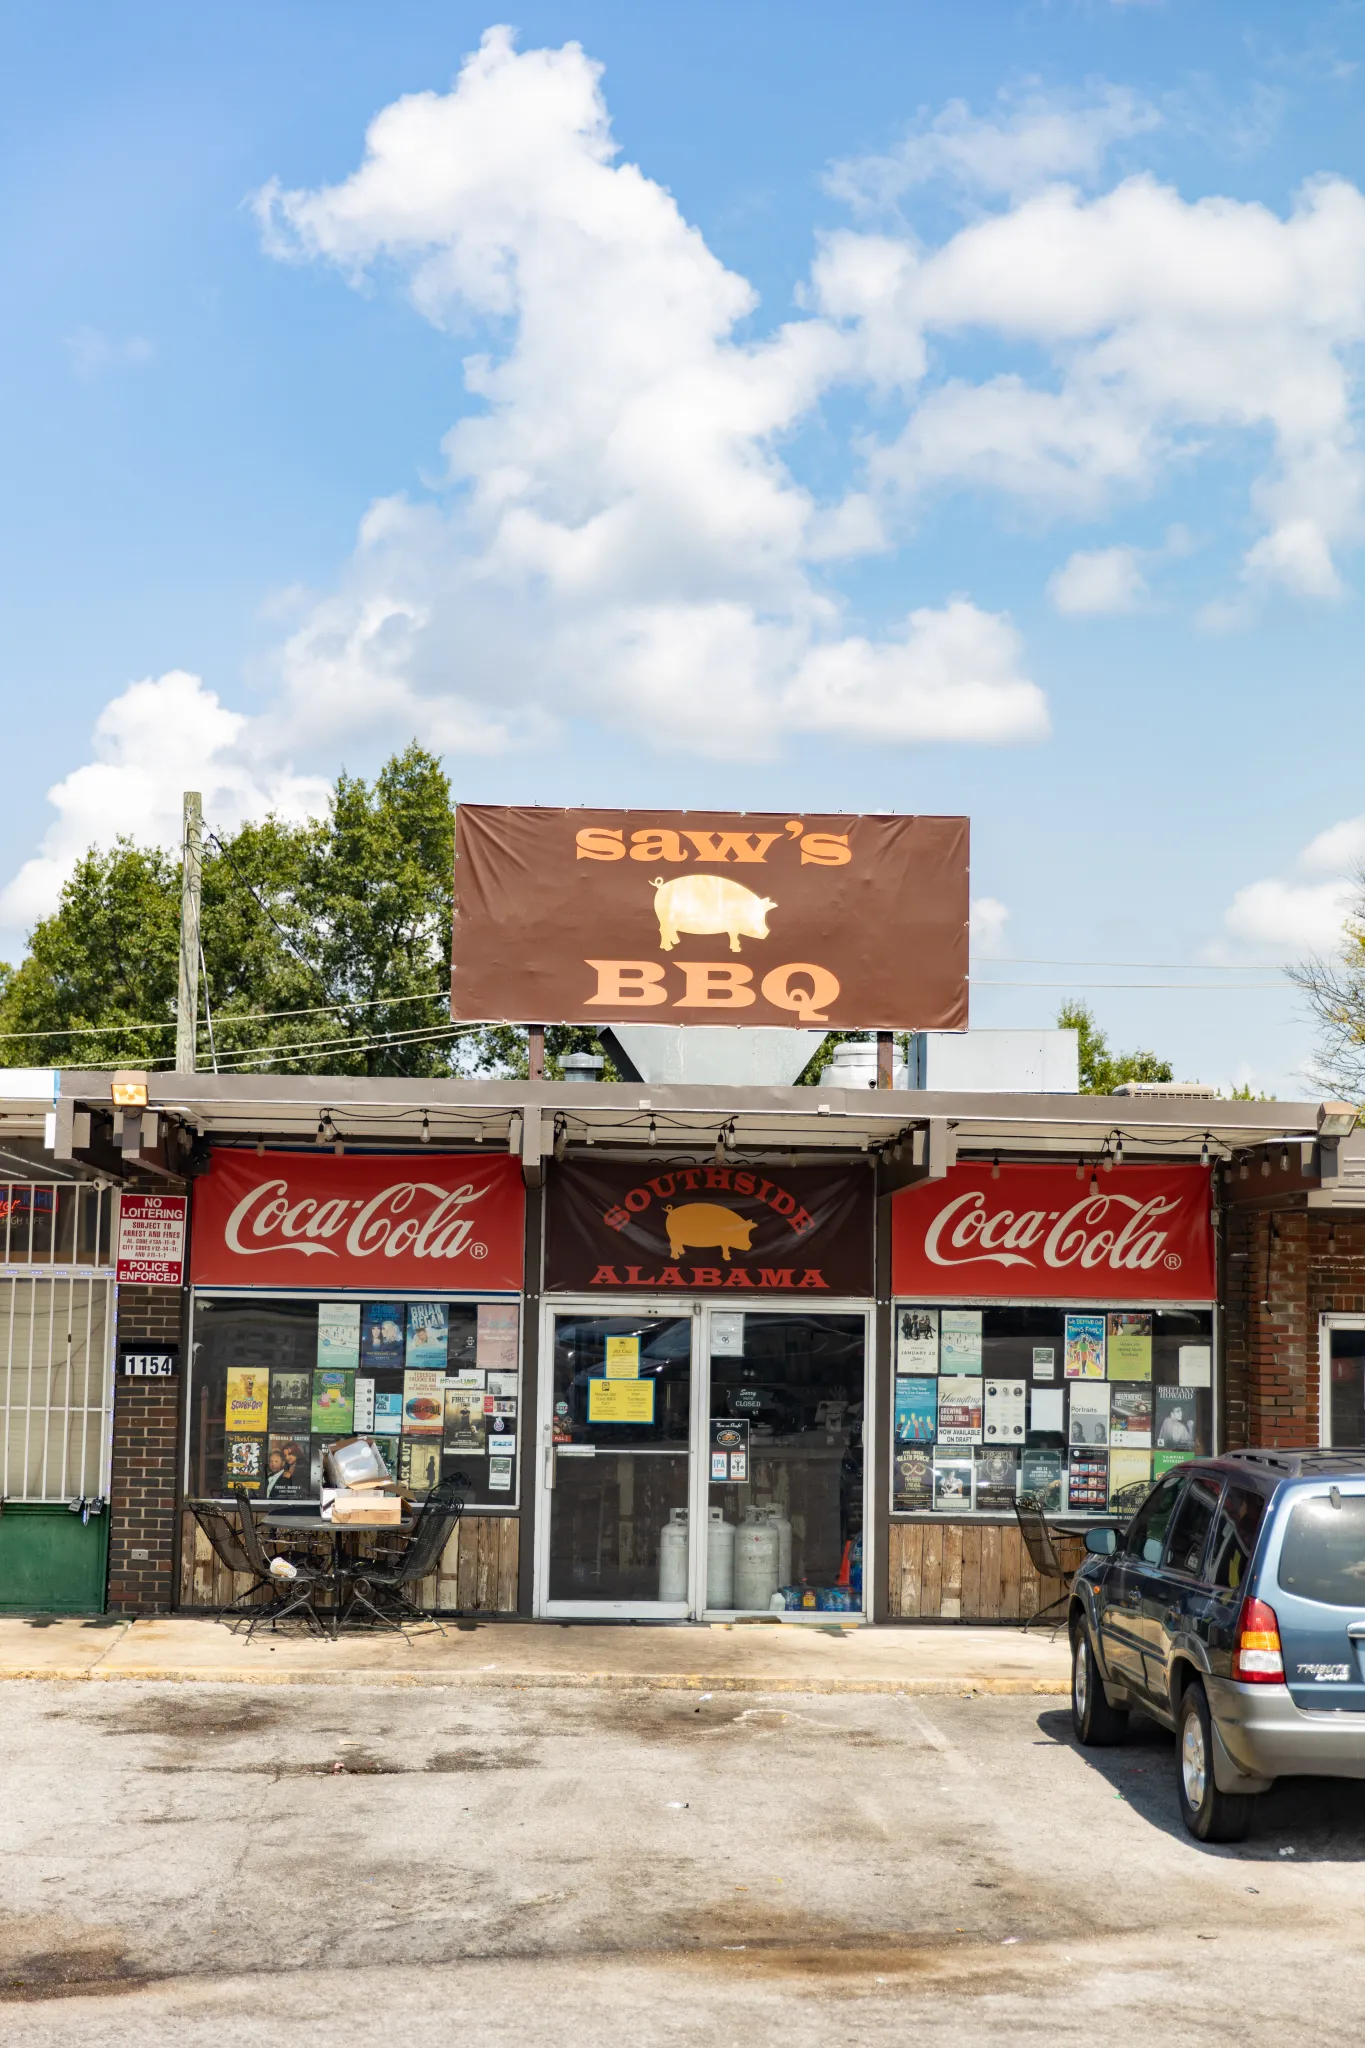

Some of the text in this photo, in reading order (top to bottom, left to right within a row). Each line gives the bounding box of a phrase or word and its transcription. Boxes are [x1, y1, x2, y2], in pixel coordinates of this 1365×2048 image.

[582, 959, 841, 1022] BBQ
[144, 1198, 162, 1208] NO
[603, 1168, 816, 1236] SOUTHSIDE
[122, 1207, 183, 1220] LOITERING
[225, 1179, 491, 1258] Coca-Cola
[1, 1216, 44, 1225] HGH LFE
[163, 1222, 172, 1230] TO
[925, 1191, 1183, 1270] Coca-Cola
[129, 1261, 169, 1272] POLICE
[119, 1271, 179, 1282] ENFORCED
[588, 1265, 831, 1287] ALABAMA
[410, 1304, 442, 1319] BRIAN
[128, 1356, 171, 1375] 1154
[740, 1389, 756, 1397] Sorry
[1158, 1386, 1195, 1394] BRITTANY
[402, 1441, 411, 1462] OUT
[713, 1459, 725, 1468] IPA
[1296, 1664, 1350, 1674] TRIBUTE
